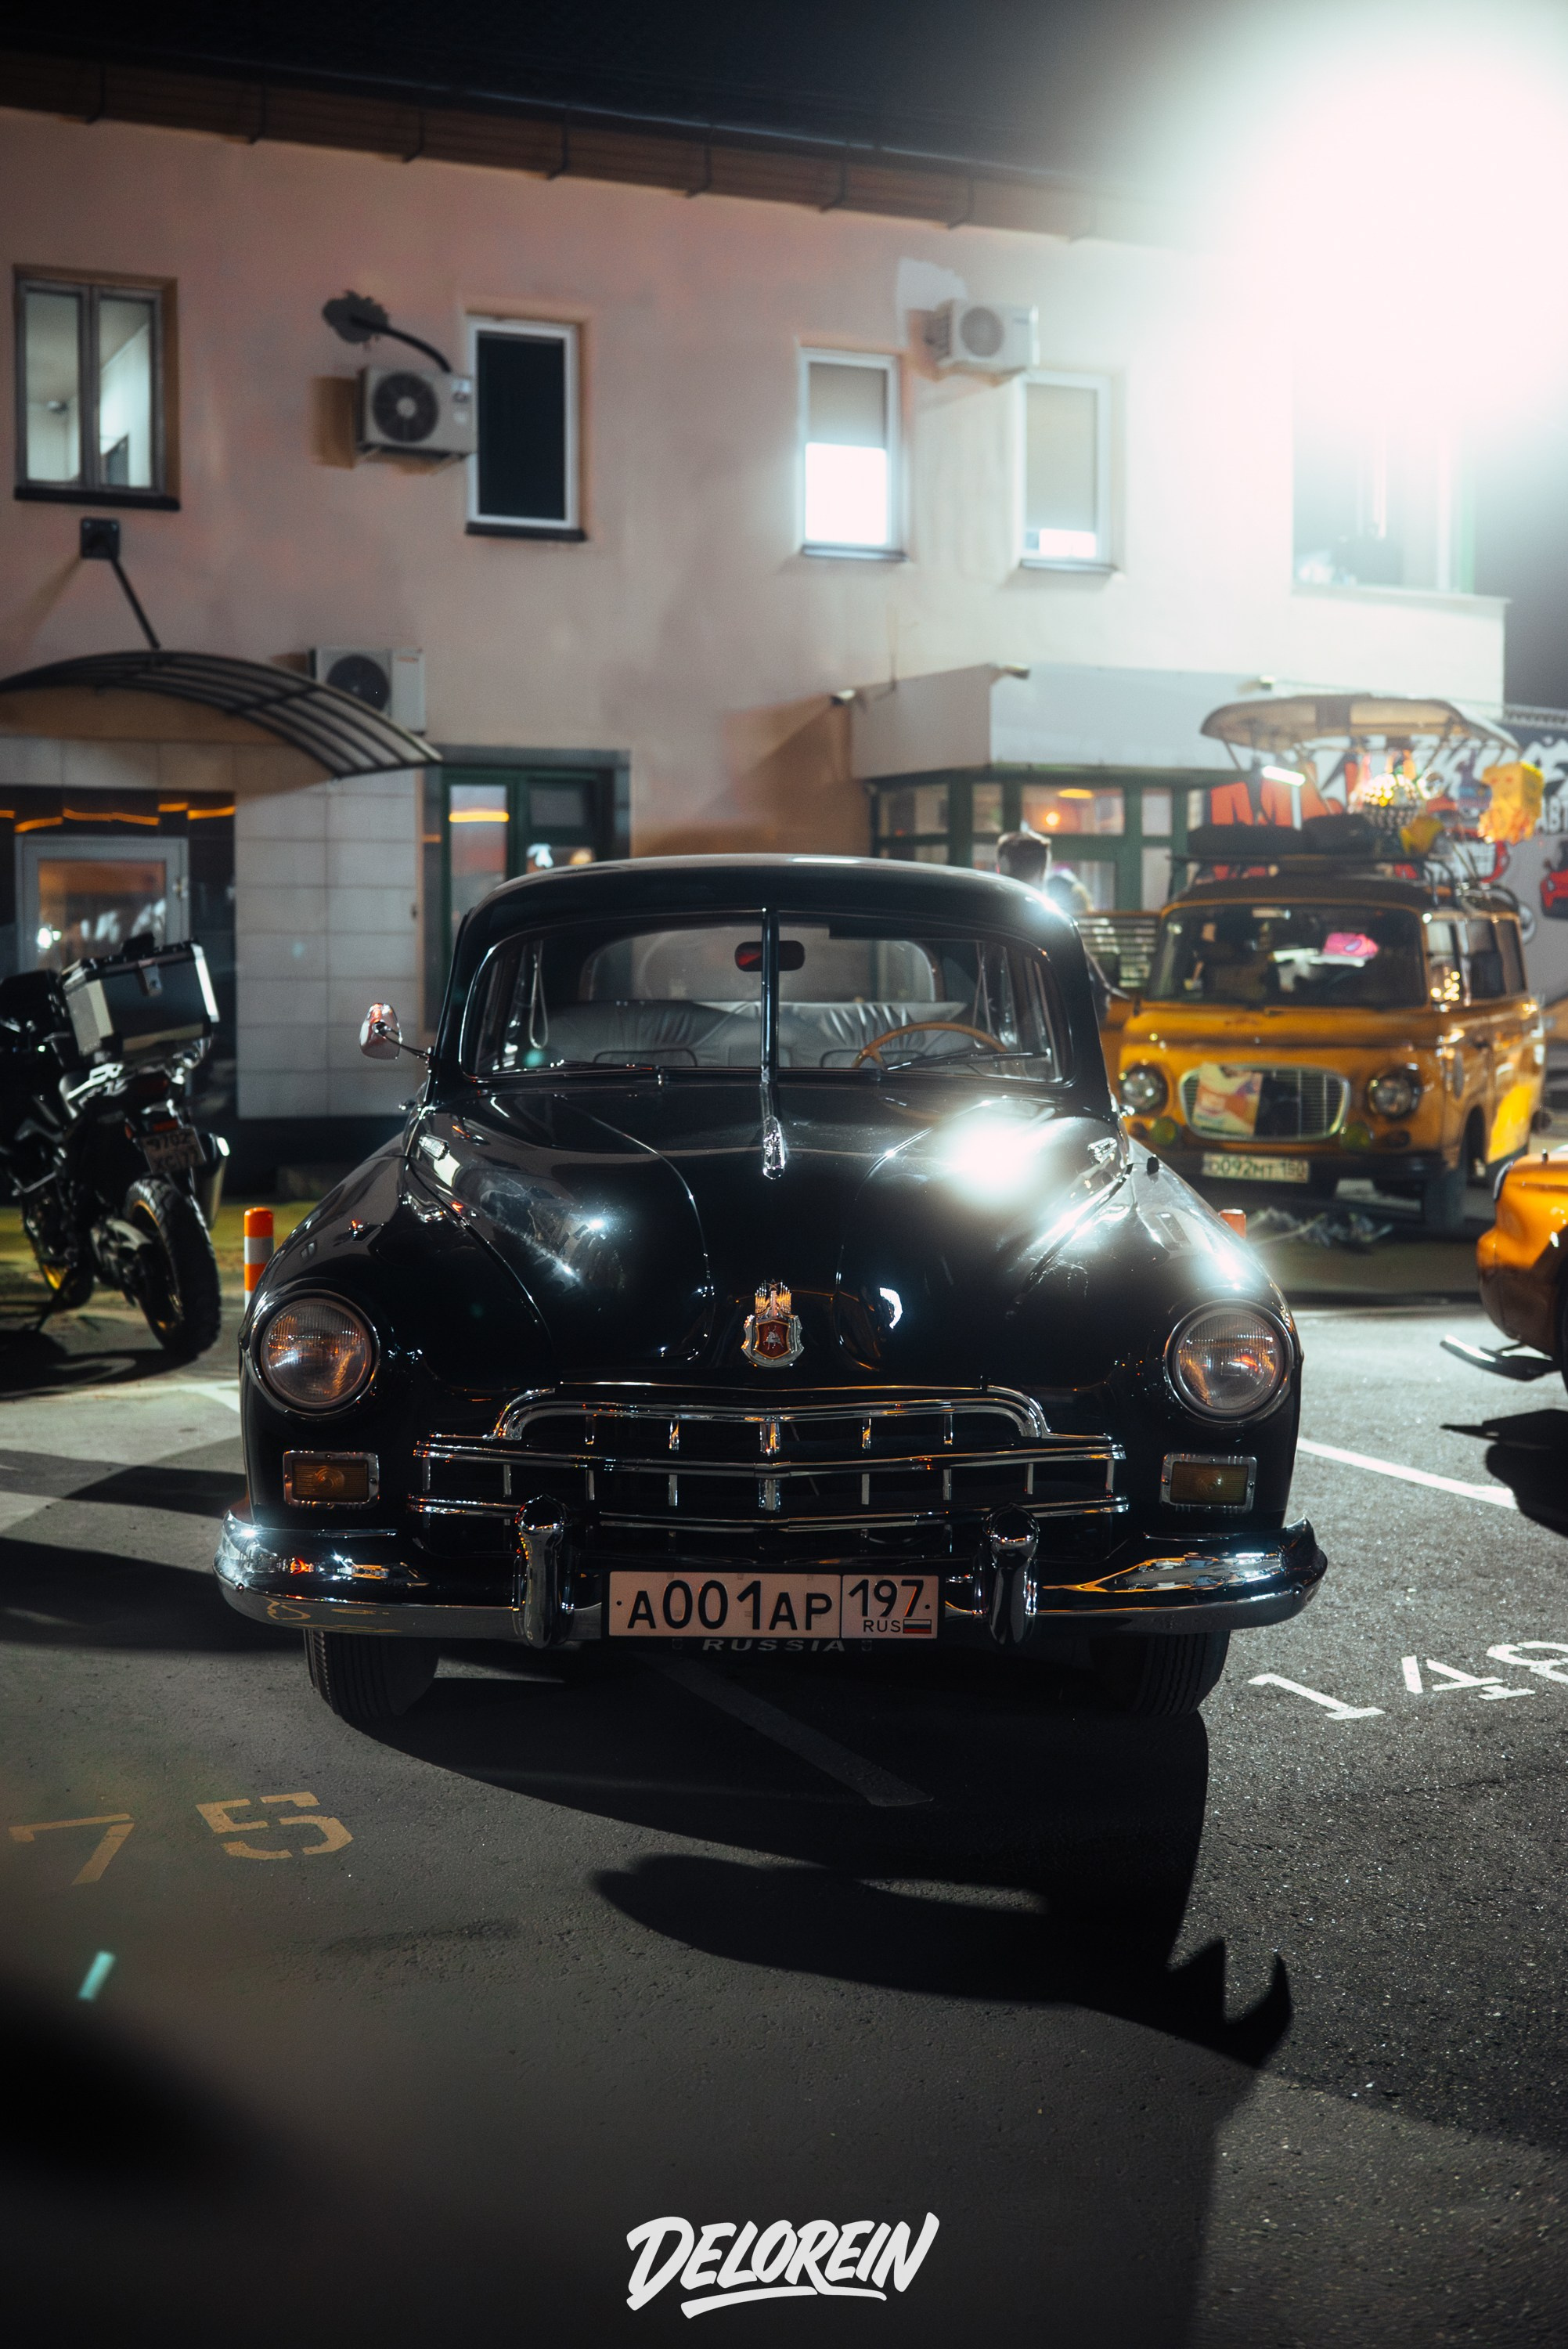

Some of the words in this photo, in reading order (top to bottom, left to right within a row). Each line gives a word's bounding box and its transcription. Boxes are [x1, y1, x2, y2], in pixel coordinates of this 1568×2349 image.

[627, 1579, 833, 1631] А001АР
[848, 1579, 925, 1618] 197
[863, 1619, 901, 1633] RUS
[702, 1639, 845, 1651] RUSSIA
[8, 1791, 354, 1885] 75
